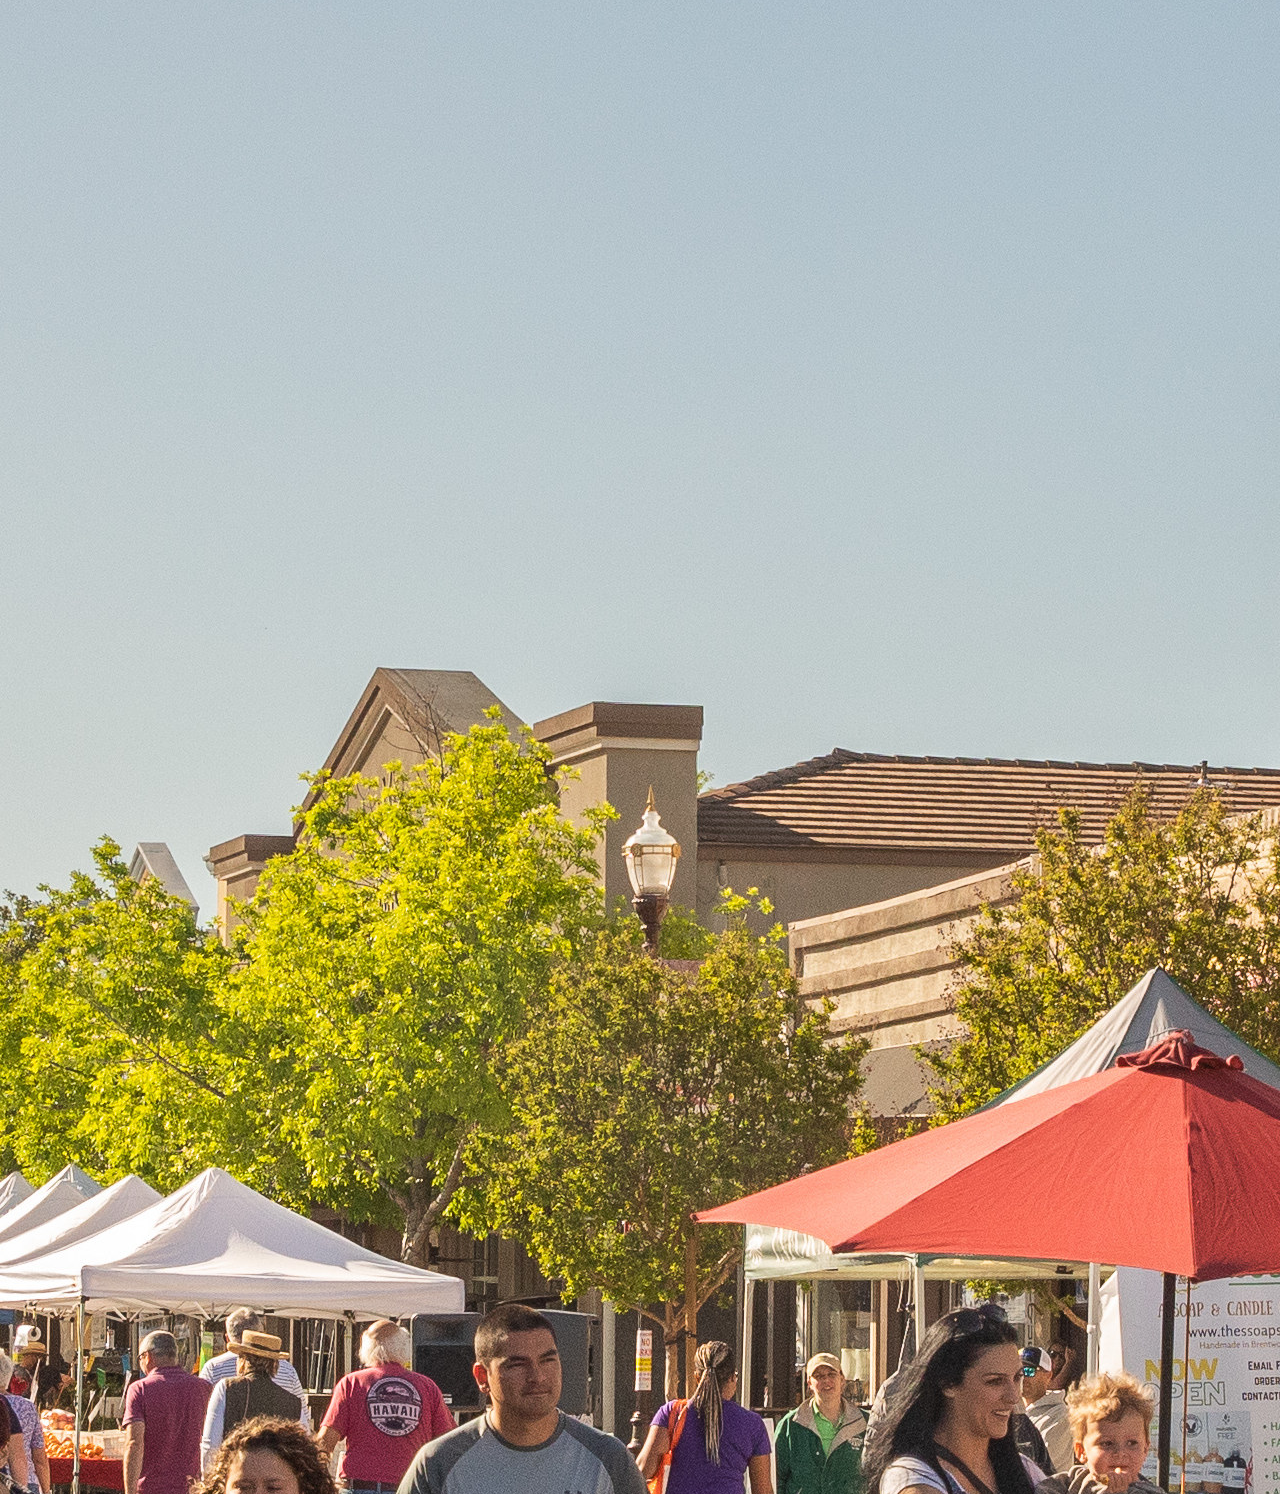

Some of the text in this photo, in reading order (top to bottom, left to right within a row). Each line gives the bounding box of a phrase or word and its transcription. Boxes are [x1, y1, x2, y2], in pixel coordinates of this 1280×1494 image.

[1226, 1300, 1274, 1316] CANDLE
[1199, 1340, 1240, 1350] Handmade
[1242, 1340, 1250, 1349] in
[1144, 1357, 1218, 1382] NOW
[373, 1404, 417, 1418] HAWAII
